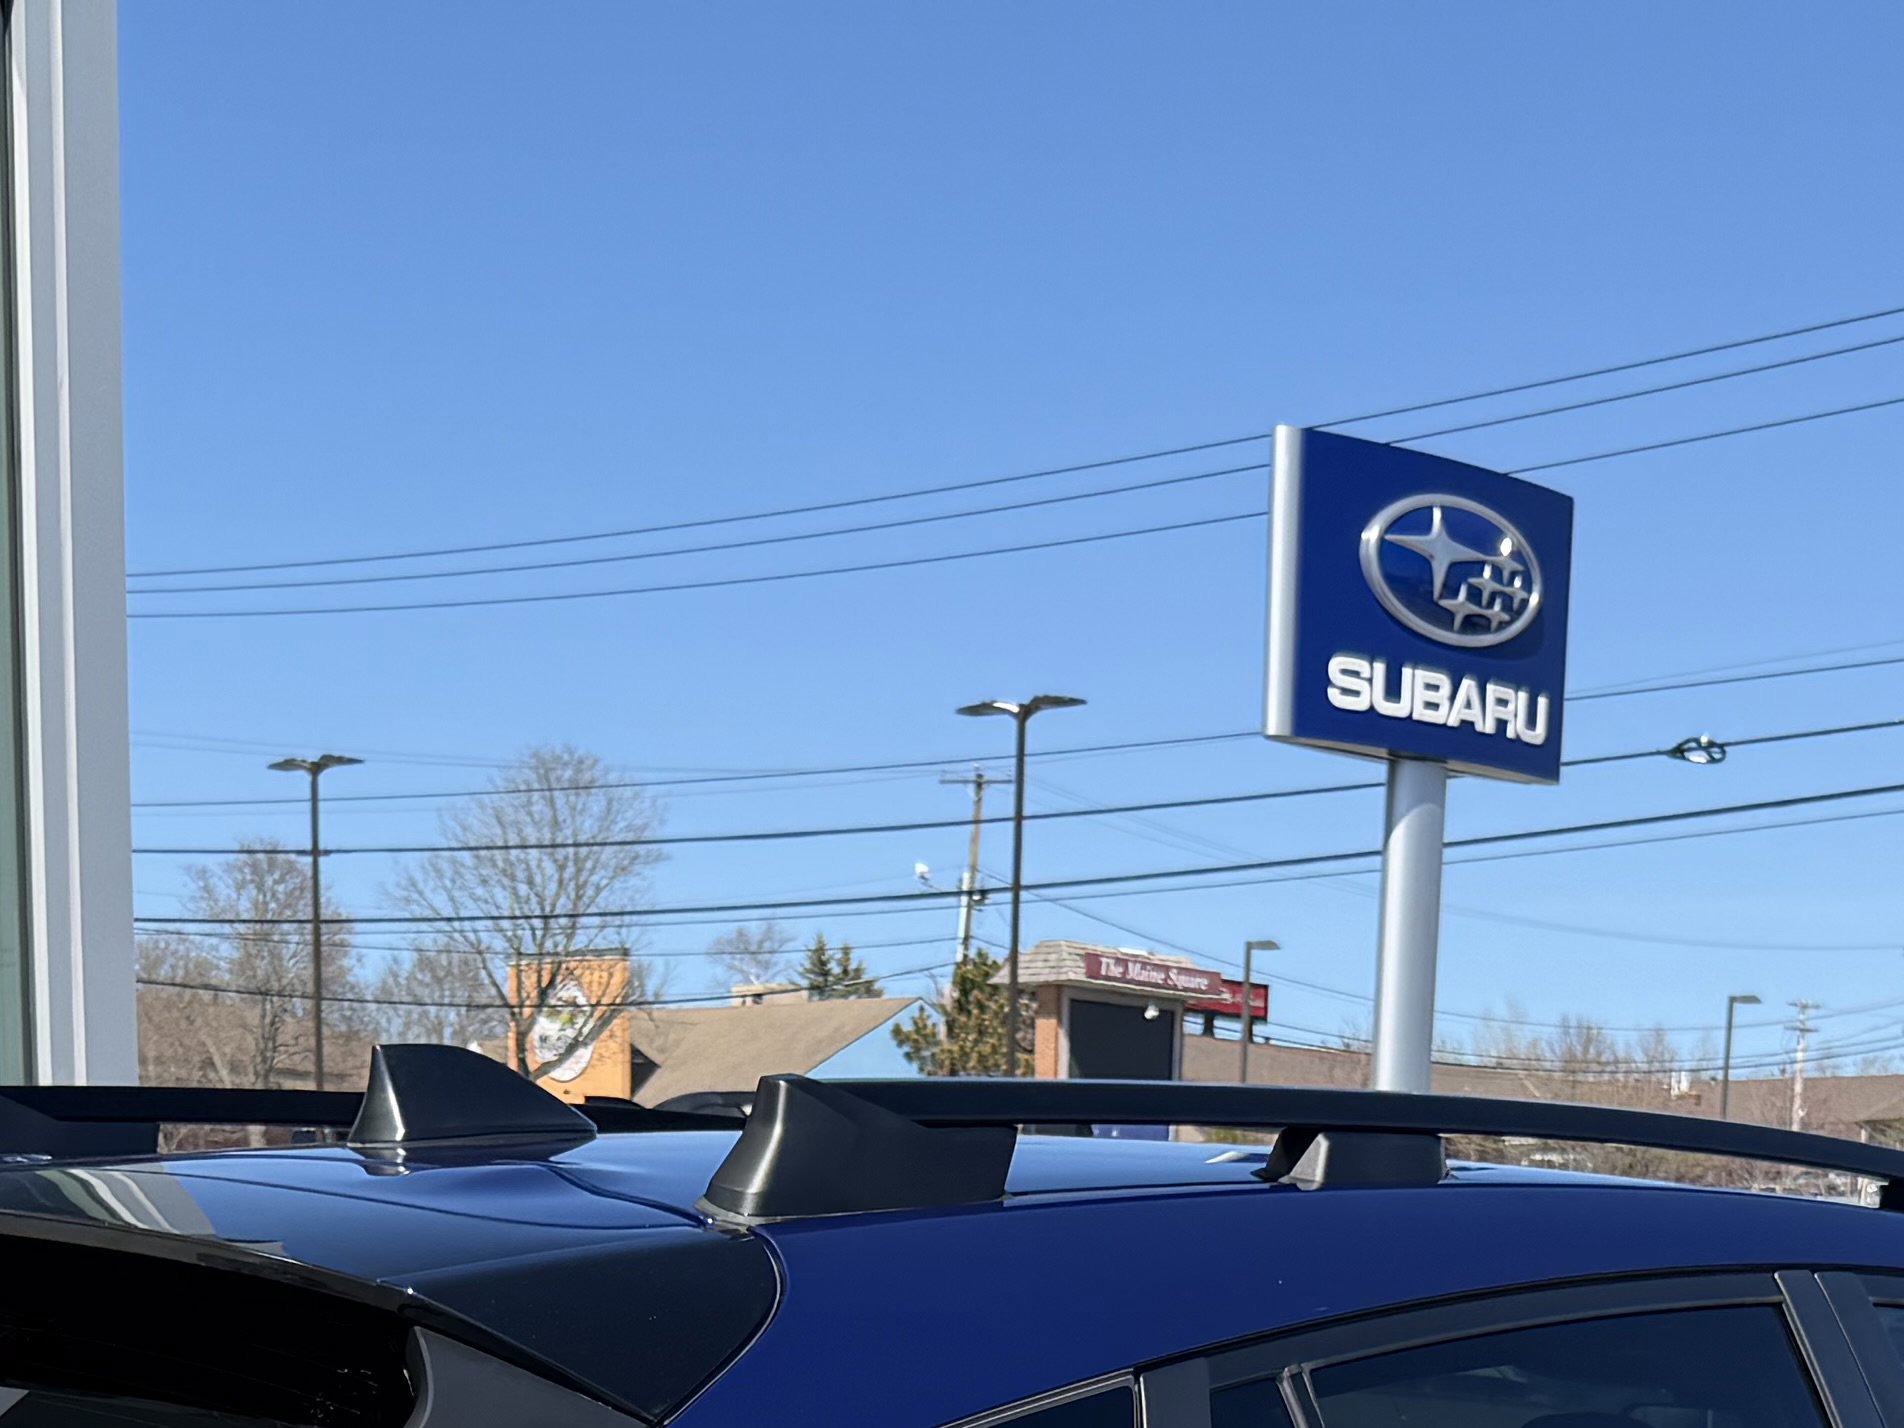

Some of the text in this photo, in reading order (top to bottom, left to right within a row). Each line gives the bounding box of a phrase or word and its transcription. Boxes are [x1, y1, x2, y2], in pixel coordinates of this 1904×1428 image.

[1327, 656, 1550, 746] SUBARU
[1099, 957, 1209, 990] The Maine Square
